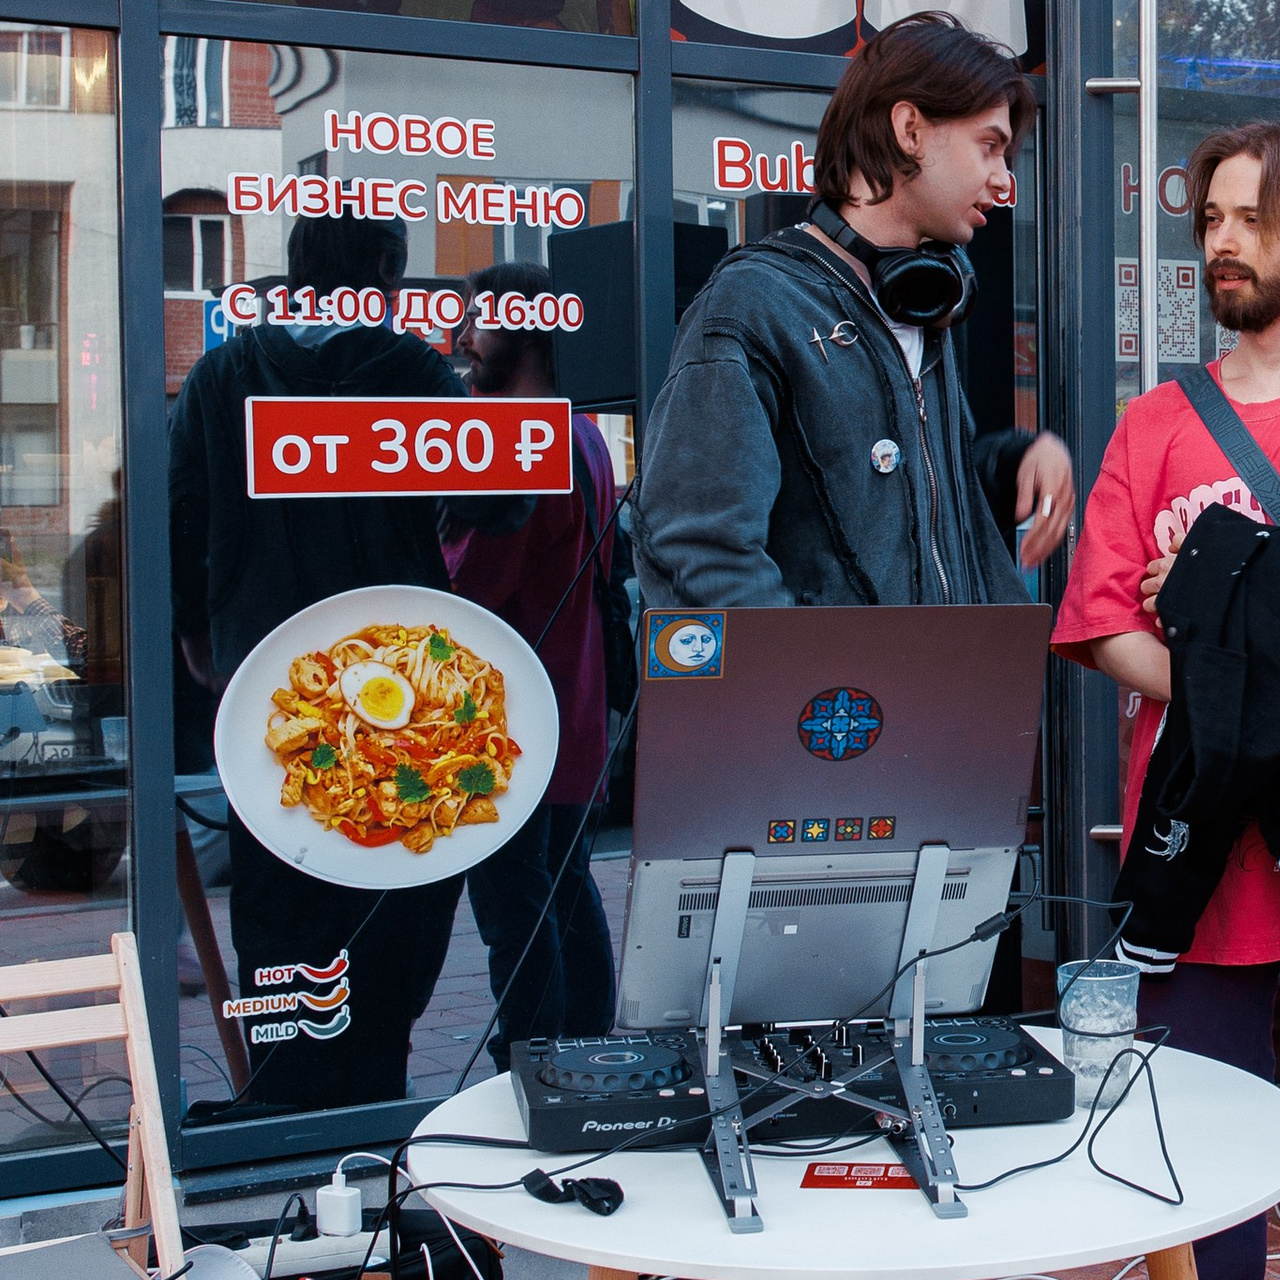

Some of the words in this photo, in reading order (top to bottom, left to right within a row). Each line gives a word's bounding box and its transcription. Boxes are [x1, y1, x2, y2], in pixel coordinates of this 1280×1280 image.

[330, 113, 495, 158] НОВОЕ
[233, 175, 427, 220] БИЗНЕС
[442, 184, 585, 230] МЕНЮ
[228, 286, 257, 321] С
[274, 288, 387, 323] 11:00
[400, 291, 466, 331] ДО
[482, 293, 584, 328] 16:00
[272, 435, 349, 474] от
[371, 418, 495, 474] 360
[259, 967, 296, 983] HOT
[227, 995, 297, 1016] MEDIUM
[255, 1024, 298, 1041] MILD
[581, 1119, 654, 1134] Pioneer
